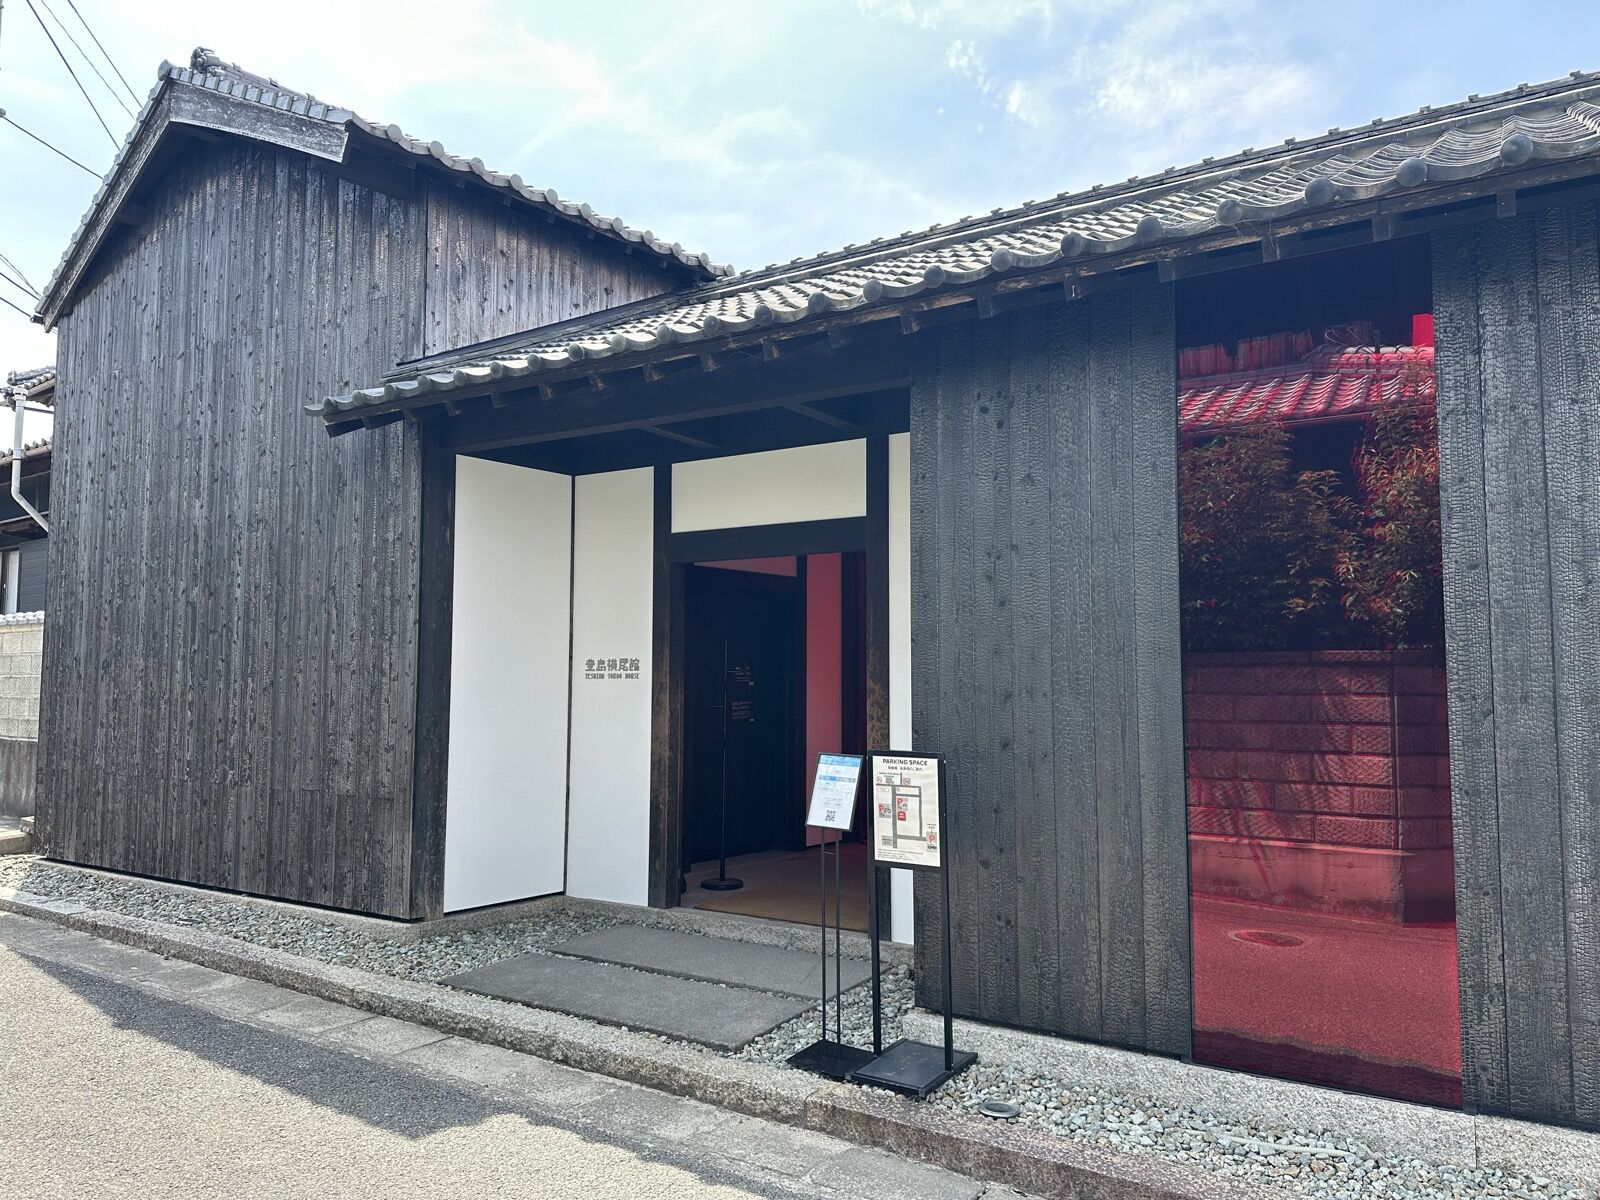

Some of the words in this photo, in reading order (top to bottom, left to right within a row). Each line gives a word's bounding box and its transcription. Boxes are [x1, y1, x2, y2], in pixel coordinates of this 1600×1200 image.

[585, 658, 639, 672] 豊島横尾館
[909, 759, 928, 767] SPACE
